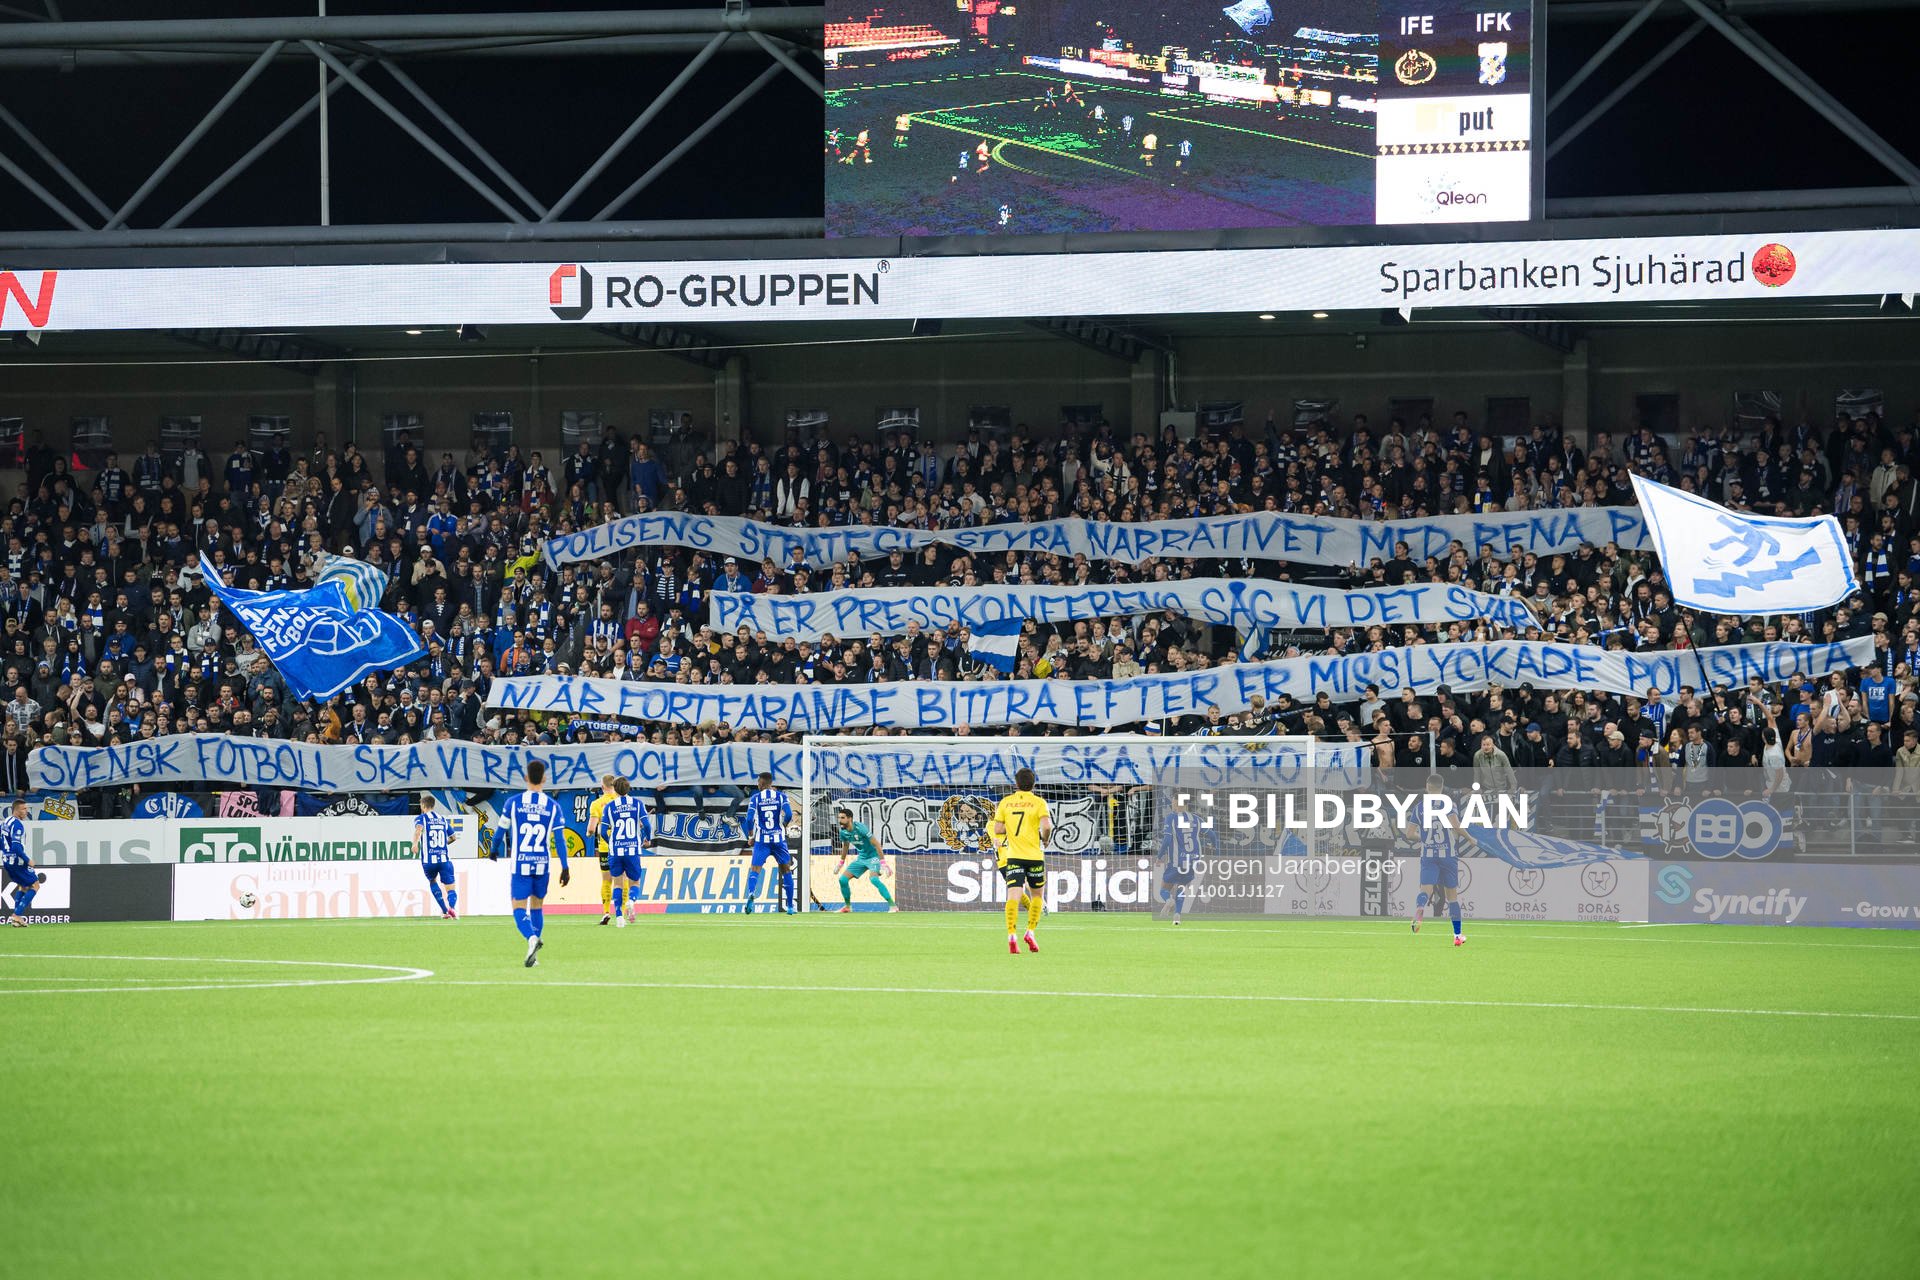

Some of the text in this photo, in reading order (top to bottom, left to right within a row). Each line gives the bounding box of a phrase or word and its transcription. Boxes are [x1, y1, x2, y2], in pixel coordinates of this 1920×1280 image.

[1401, 16, 1434, 35] IFE
[1477, 12, 1512, 32] IFK
[1437, 191, 1487, 205] Qlean
[1380, 251, 1745, 298] Sparbanken Sjuhärad
[607, 273, 878, 308] RO-GRUPPEN
[550, 515, 714, 564] POLISENS
[955, 524, 1071, 553] STYRA
[1085, 517, 1336, 561] NARRATIVET
[1473, 514, 1585, 557] RENA
[714, 595, 758, 627] PÅ
[772, 599, 817, 634] ER
[1201, 581, 1281, 628] SÅG
[1288, 590, 1327, 627] VI
[1345, 587, 1430, 623] DET
[545, 676, 606, 713] ÄR
[619, 686, 898, 731] FORTFARANDE
[917, 683, 1058, 726] BITTRA
[1074, 671, 1219, 724] EFTER
[1235, 664, 1292, 704] ER
[1308, 643, 1602, 695] MISSLYCKADE
[1625, 642, 1856, 696] POLISNOTA
[39, 741, 182, 787] SVENSK
[197, 736, 338, 789] FOTBOLL
[354, 744, 428, 783] SKA
[436, 744, 469, 781] VI
[614, 749, 679, 781] OCH
[1060, 745, 1143, 784] SKA
[1146, 746, 1182, 785] VI
[1200, 745, 1363, 787] SKROA!
[574, 795, 589, 809] OK
[616, 817, 636, 840] 20
[765, 811, 774, 829] 3
[1012, 811, 1025, 837] 7
[429, 830, 445, 848] 30
[520, 823, 546, 852] 22
[1184, 833, 1194, 852] 5
[637, 860, 780, 900] LÅKLÄDE
[230, 871, 469, 919] Sandwal
[1505, 899, 1547, 912] BORÅS
[1693, 888, 1807, 921] Syncify
[1578, 900, 1620, 914] BORÅS
[1856, 901, 1909, 918] Grow
[0, 915, 70, 925] GADEROBER
